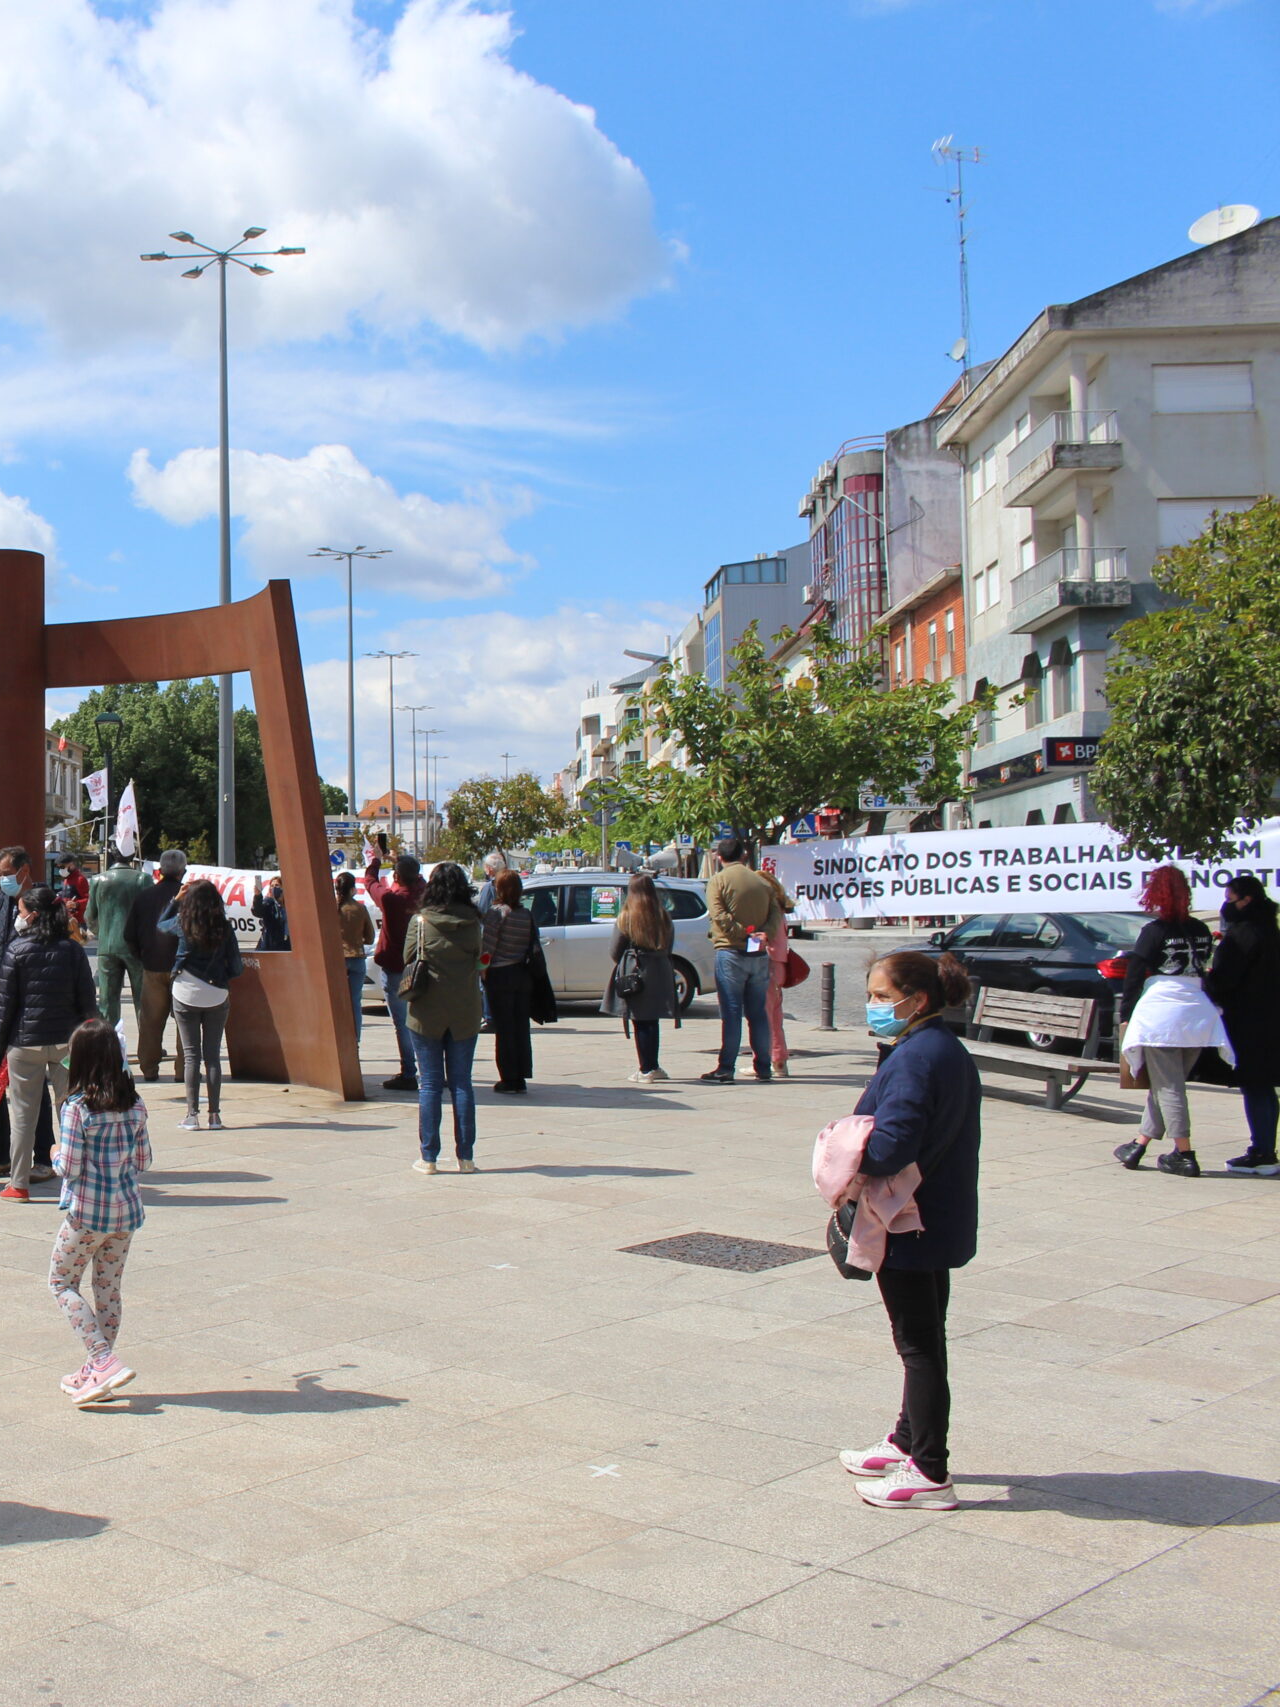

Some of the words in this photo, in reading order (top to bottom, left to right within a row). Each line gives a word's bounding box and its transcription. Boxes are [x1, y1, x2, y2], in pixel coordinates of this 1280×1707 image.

[813, 852, 920, 876] SINDICATO
[926, 850, 972, 870] DOS
[796, 877, 885, 902] FUNÇÕES
[891, 873, 1000, 897] PÚBLICAS
[1007, 875, 1021, 893] E
[1028, 871, 1133, 892] SOCIAIS
